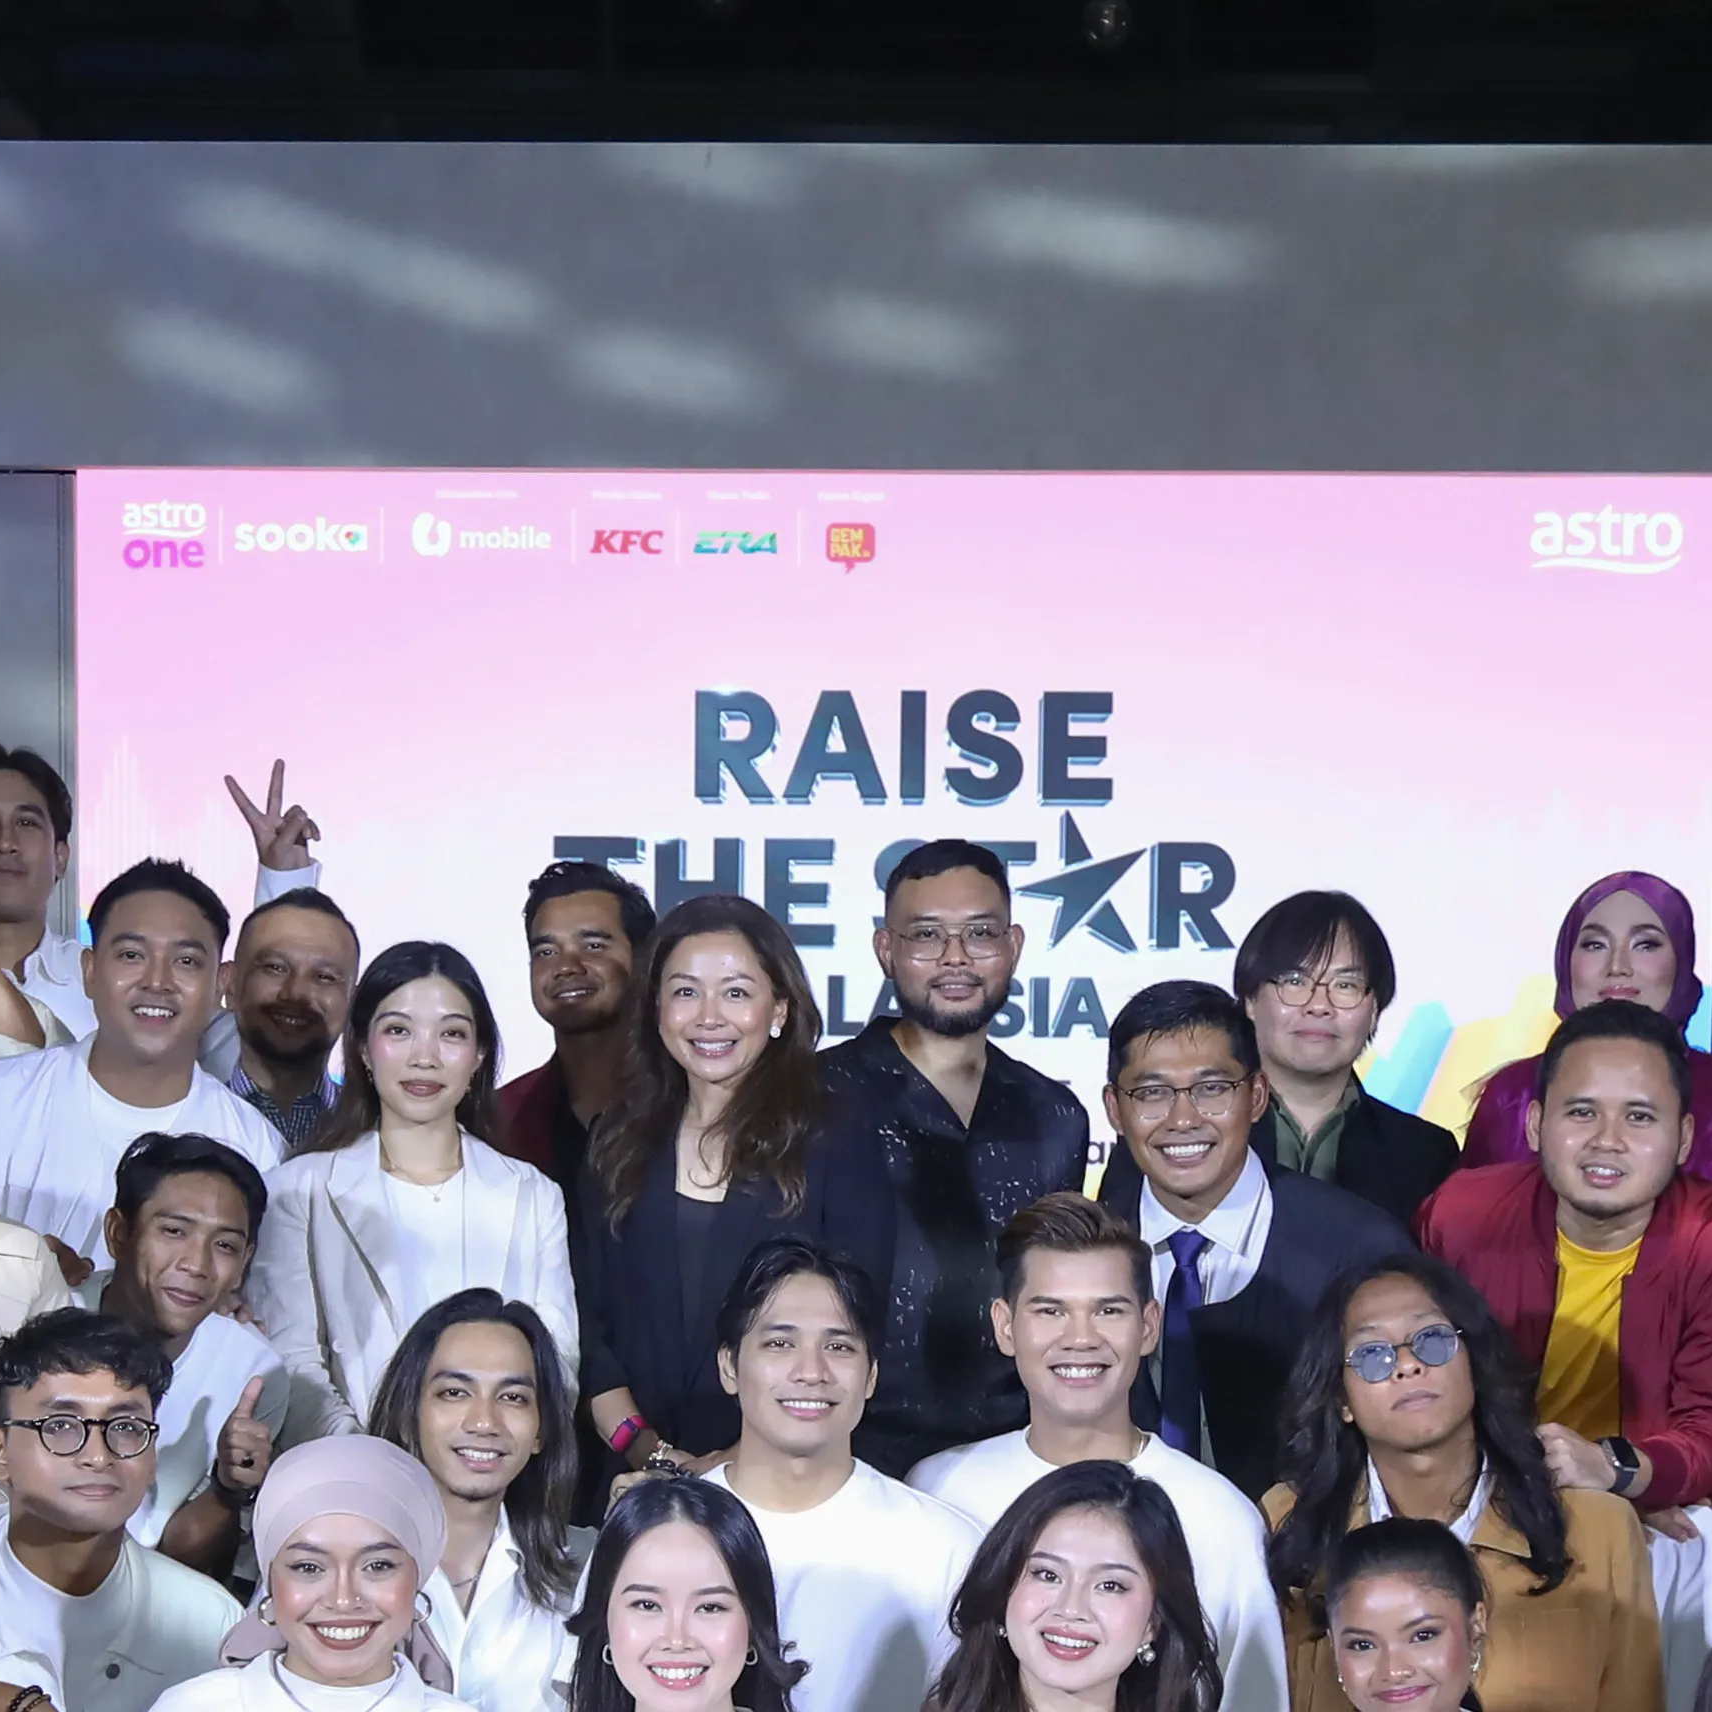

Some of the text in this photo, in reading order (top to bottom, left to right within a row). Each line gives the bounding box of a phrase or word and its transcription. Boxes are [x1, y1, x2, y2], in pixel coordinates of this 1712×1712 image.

[122, 498, 206, 530] astro
[234, 516, 368, 552] sooka
[459, 526, 552, 550] mobile
[590, 530, 664, 555] KFC
[693, 531, 778, 554] ERA
[1529, 503, 1684, 558] astro
[123, 538, 205, 570] one
[693, 689, 1114, 807] RAISE
